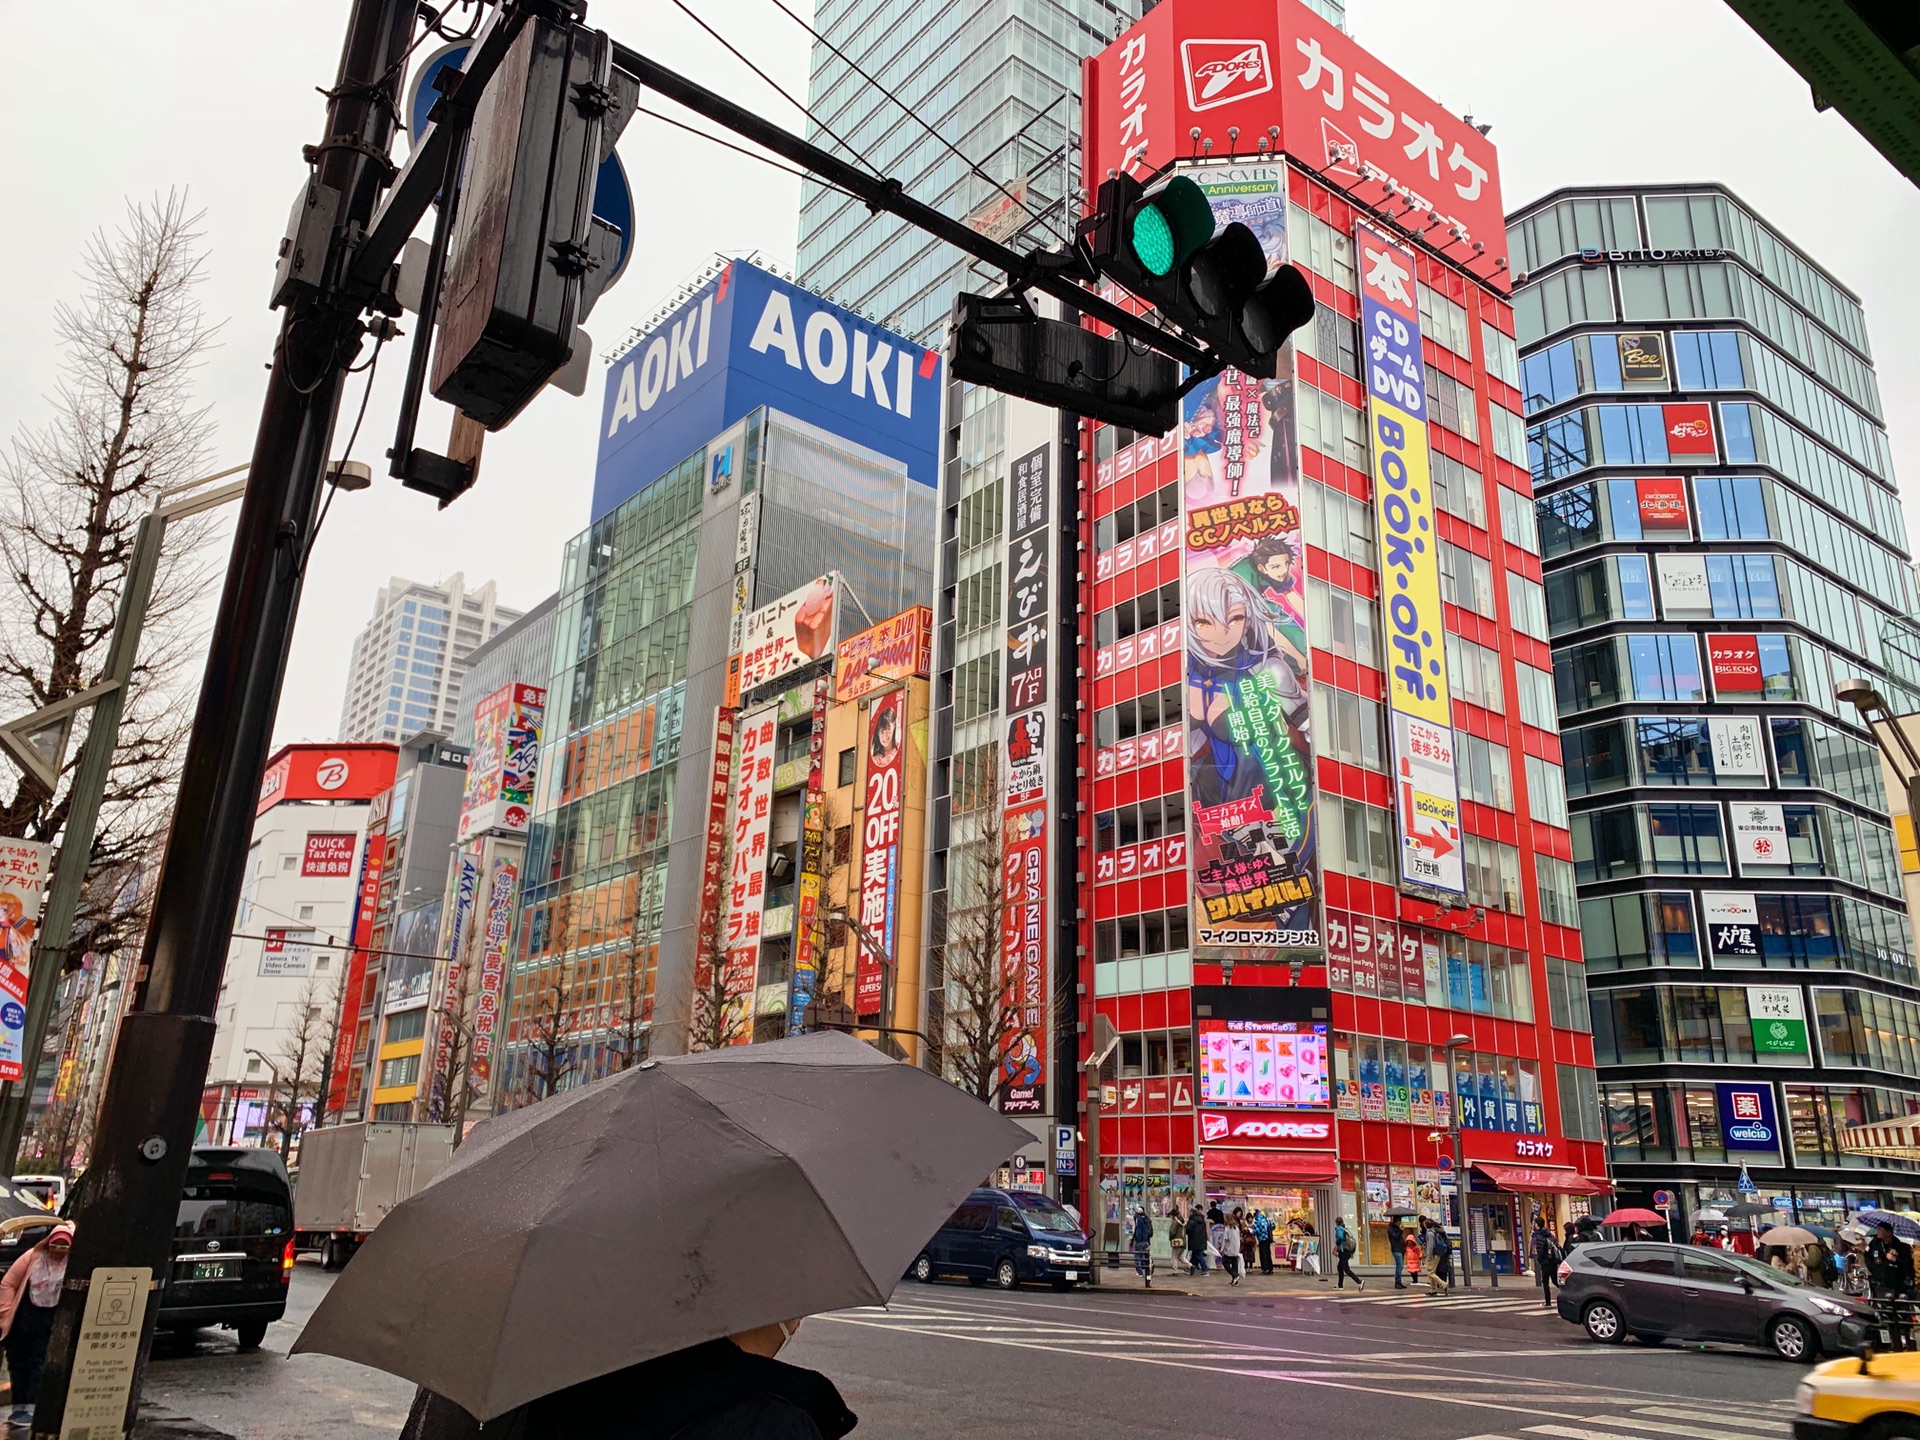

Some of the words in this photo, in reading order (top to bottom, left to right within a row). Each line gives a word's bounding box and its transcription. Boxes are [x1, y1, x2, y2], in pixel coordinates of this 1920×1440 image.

[1195, 60, 1261, 77] ADORES
[1120, 33, 1149, 176] カラオケ
[1296, 37, 1489, 201] カラオケ
[1217, 168, 1278, 182] NOVELS
[1208, 183, 1276, 195] Anniversary
[1672, 249, 1727, 257] AKIBA
[1365, 247, 1413, 309] 本
[1375, 310, 1410, 347] CD
[608, 293, 714, 439] AOKI
[749, 290, 914, 419] AOKI
[1370, 334, 1420, 384] ゲーム
[1623, 349, 1660, 364] Bee
[1373, 365, 1421, 411] DVD
[1225, 365, 1244, 496] せ、最強魔導師!
[1097, 429, 1177, 485] カラオケ
[1016, 461, 1028, 532] 和食居酒屋
[1029, 453, 1043, 524] 個室完備
[1191, 495, 1284, 530] 異世界なら
[1641, 500, 1682, 511] 北海道
[1188, 510, 1297, 549] GCノベルズ!
[1097, 524, 1178, 576] カラオケ
[737, 559, 749, 572] 8F
[756, 600, 798, 629] ハニトー
[894, 613, 914, 638] DVD
[766, 627, 774, 639] &
[745, 636, 795, 669] 曲数世界一
[1097, 623, 1180, 673] カラオケ
[1713, 650, 1756, 659] カラオケ
[742, 652, 793, 688] カラオケ
[1026, 666, 1042, 684] 入口
[1715, 665, 1732, 673] BIG
[1733, 665, 1758, 673] ECHO
[848, 680, 870, 697] ラムタラ
[1257, 675, 1308, 811] 美人ダークエルフと
[1410, 723, 1440, 744] ここから
[1097, 730, 1182, 774] カラオケ
[1239, 679, 1300, 838] 自給自足のクラフト生活
[1411, 738, 1451, 763] 徒歩3分
[868, 769, 899, 816] 20%
[1008, 776, 1044, 794] セセリ焼き
[1020, 791, 1031, 802] 5F
[1200, 798, 1258, 823] コミカライズ
[1220, 814, 1245, 829] 始動!
[727, 727, 757, 943] カラオケパセラ
[746, 720, 775, 937] 曲数世界最強
[805, 831, 822, 844] アイドル
[866, 813, 899, 848] OFF
[308, 849, 326, 859] Tax
[328, 849, 352, 859] Free
[309, 838, 346, 849] QUICK
[1756, 840, 1770, 853] 松
[10, 860, 39, 876] 安心
[305, 861, 349, 873] 快速免税
[1098, 839, 1185, 878] カラオケ
[1201, 856, 1272, 883] ご主人様とゆく
[1414, 858, 1440, 878] 万世橋
[361, 870, 379, 921] 坂口電熱
[459, 859, 476, 910] AKKY
[1025, 848, 1040, 942] CRANE
[1224, 871, 1269, 895] 異世界
[861, 849, 887, 965] 実施中
[1206, 876, 1314, 921] サバイバル!
[797, 895, 817, 964] DVD
[1200, 930, 1319, 945] マイクロマガジン社
[1328, 919, 1419, 962] カラオケ
[1718, 925, 1756, 949] 大戸屋
[1329, 952, 1351, 963] Karaoke
[859, 981, 875, 994] SUPER
[1025, 944, 1040, 1027] GAME
[1331, 967, 1349, 982] 3F
[1354, 971, 1375, 989] 受付
[473, 953, 502, 1056] 愛客免税店
[1, 1062, 19, 1076] Area
[1004, 1100, 1040, 1111] アドアーズ
[1464, 1097, 1537, 1124] 外貨両替
[1737, 1096, 1757, 1115] 薬
[1059, 1129, 1072, 1148] P
[1232, 1121, 1329, 1138] ADORES
[1733, 1128, 1767, 1139] welcia
[1516, 1140, 1553, 1157] カラオケ
[1056, 1159, 1066, 1169] IN
[83, 1331, 137, 1340] 夜間歩行者用
[90, 1342, 126, 1350] 押ボタン
